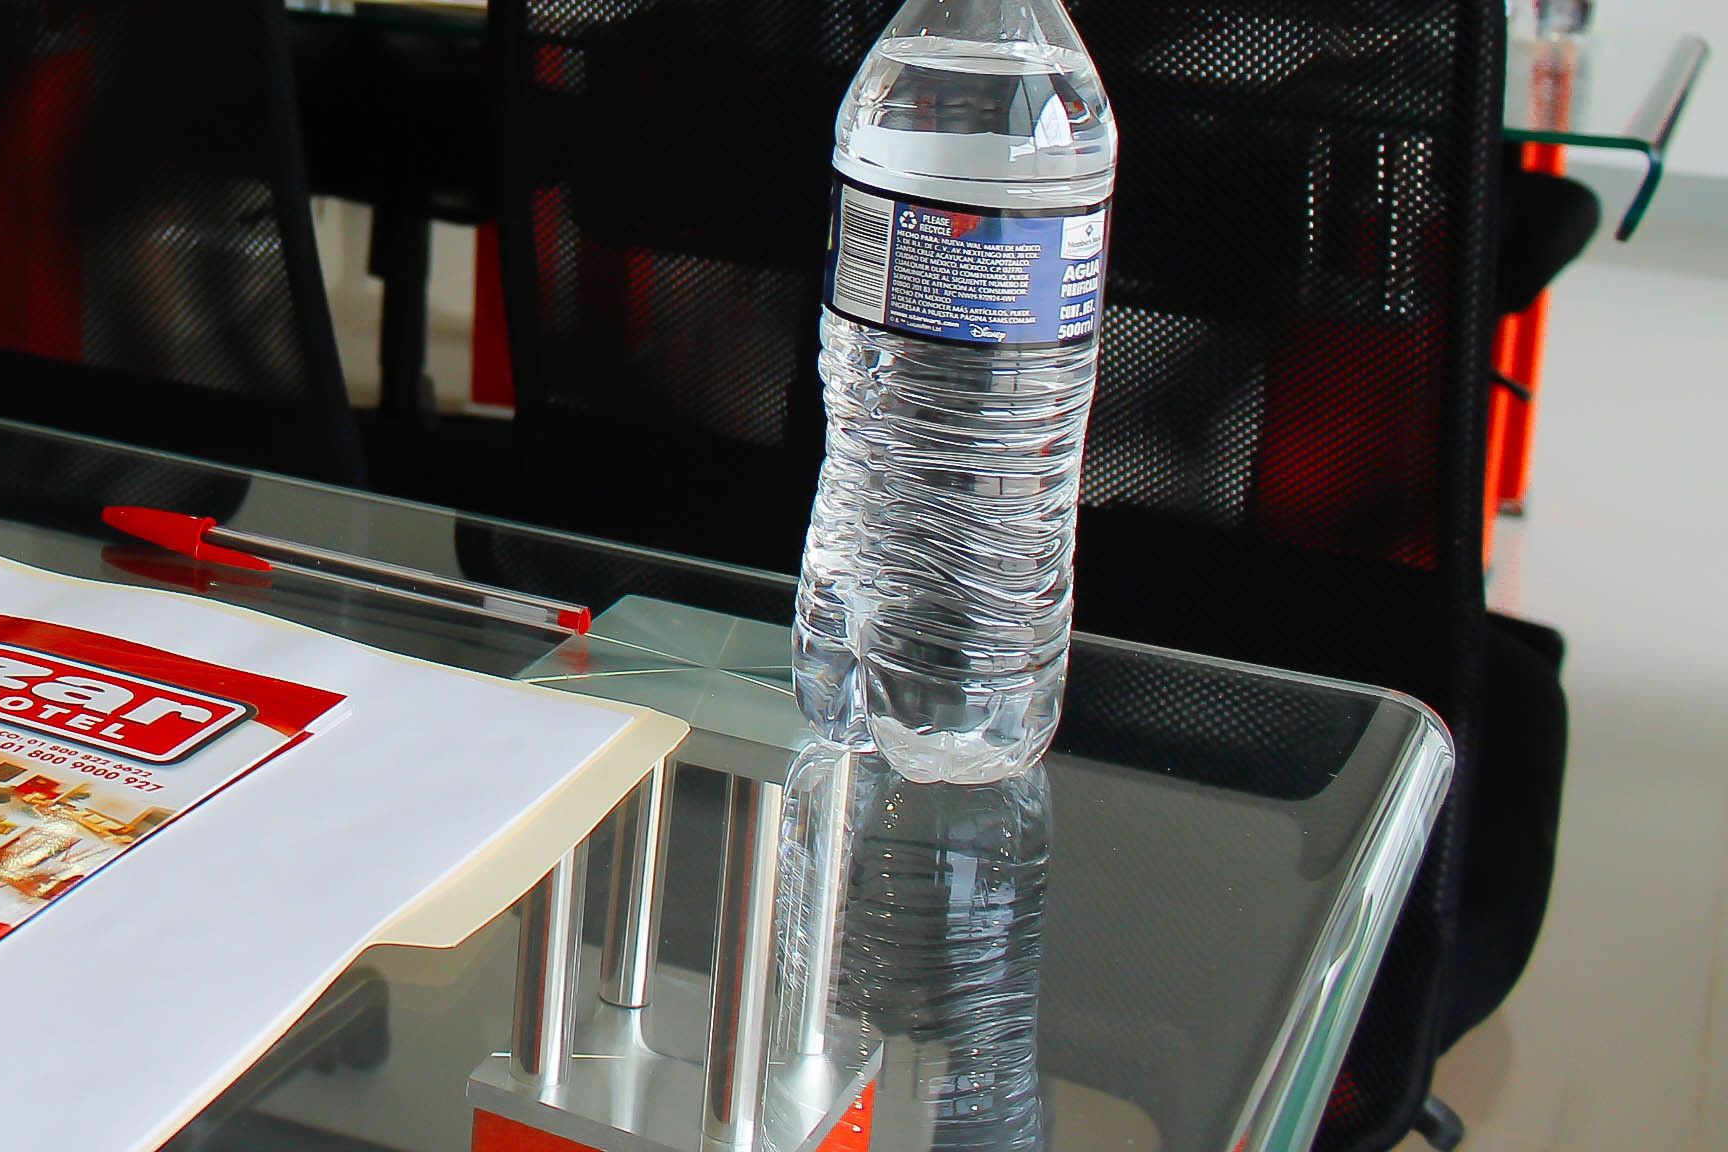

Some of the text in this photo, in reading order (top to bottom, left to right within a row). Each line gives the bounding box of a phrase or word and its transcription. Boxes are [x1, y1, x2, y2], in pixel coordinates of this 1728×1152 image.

[922, 214, 951, 226] PLEASE
[919, 223, 952, 236] RECYCLE
[896, 229, 919, 240] HECHO
[941, 238, 965, 247] NUEVA
[895, 243, 916, 253] SANTA
[917, 249, 935, 257] CRUZ
[895, 251, 919, 261] CIUDAD
[931, 266, 951, 274] DUDA
[1062, 258, 1100, 283] AGUA
[893, 272, 920, 283] SERVICIO
[951, 276, 987, 287] SIGUIENTE
[891, 287, 913, 296] HECHO
[897, 295, 917, 304] DESEA
[917, 299, 951, 311] CONOCER
[952, 305, 968, 314] MÁS
[927, 309, 959, 319] NUESTRA
[1057, 314, 1094, 340] 500ml
[27, 738, 47, 747] 01
[49, 745, 79, 756] 800
[0, 741, 25, 753] 01
[27, 749, 68, 765] 800
[71, 761, 121, 780] 9000
[123, 776, 165, 792] 927
